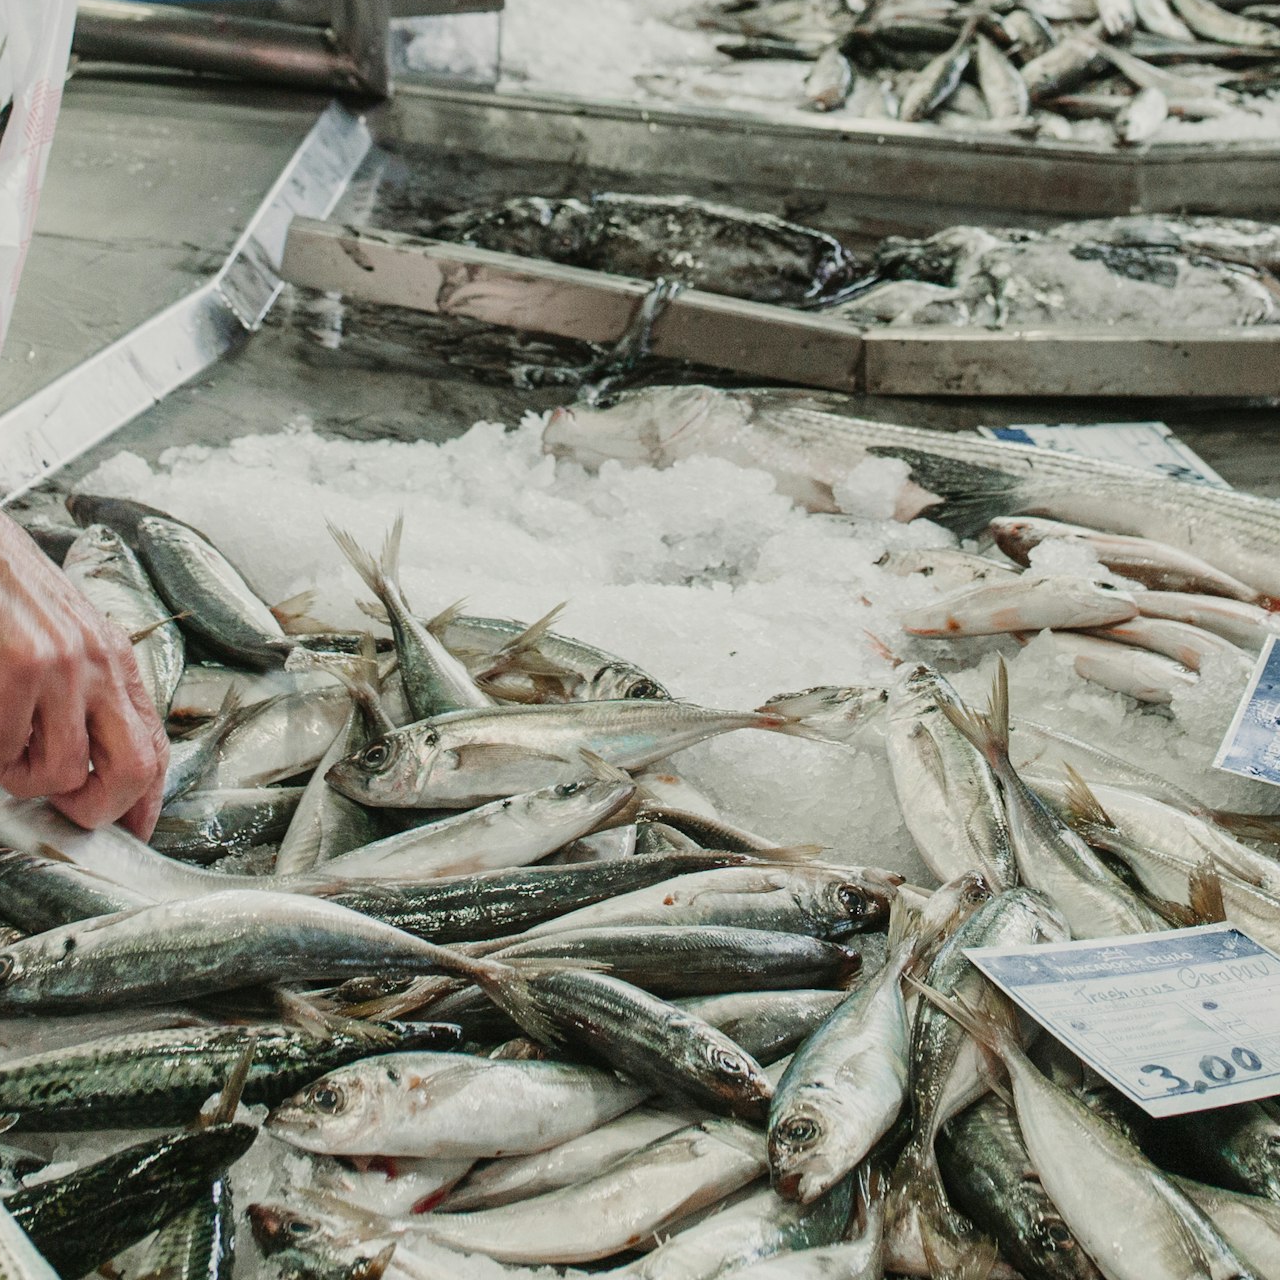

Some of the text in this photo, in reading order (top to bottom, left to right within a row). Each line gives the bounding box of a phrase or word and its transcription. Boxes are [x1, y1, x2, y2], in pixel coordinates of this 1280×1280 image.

[1057, 960, 1129, 975] MERCADOS
[1145, 950, 1195, 965] OLHÃO
[1177, 959, 1271, 989] Carapau
